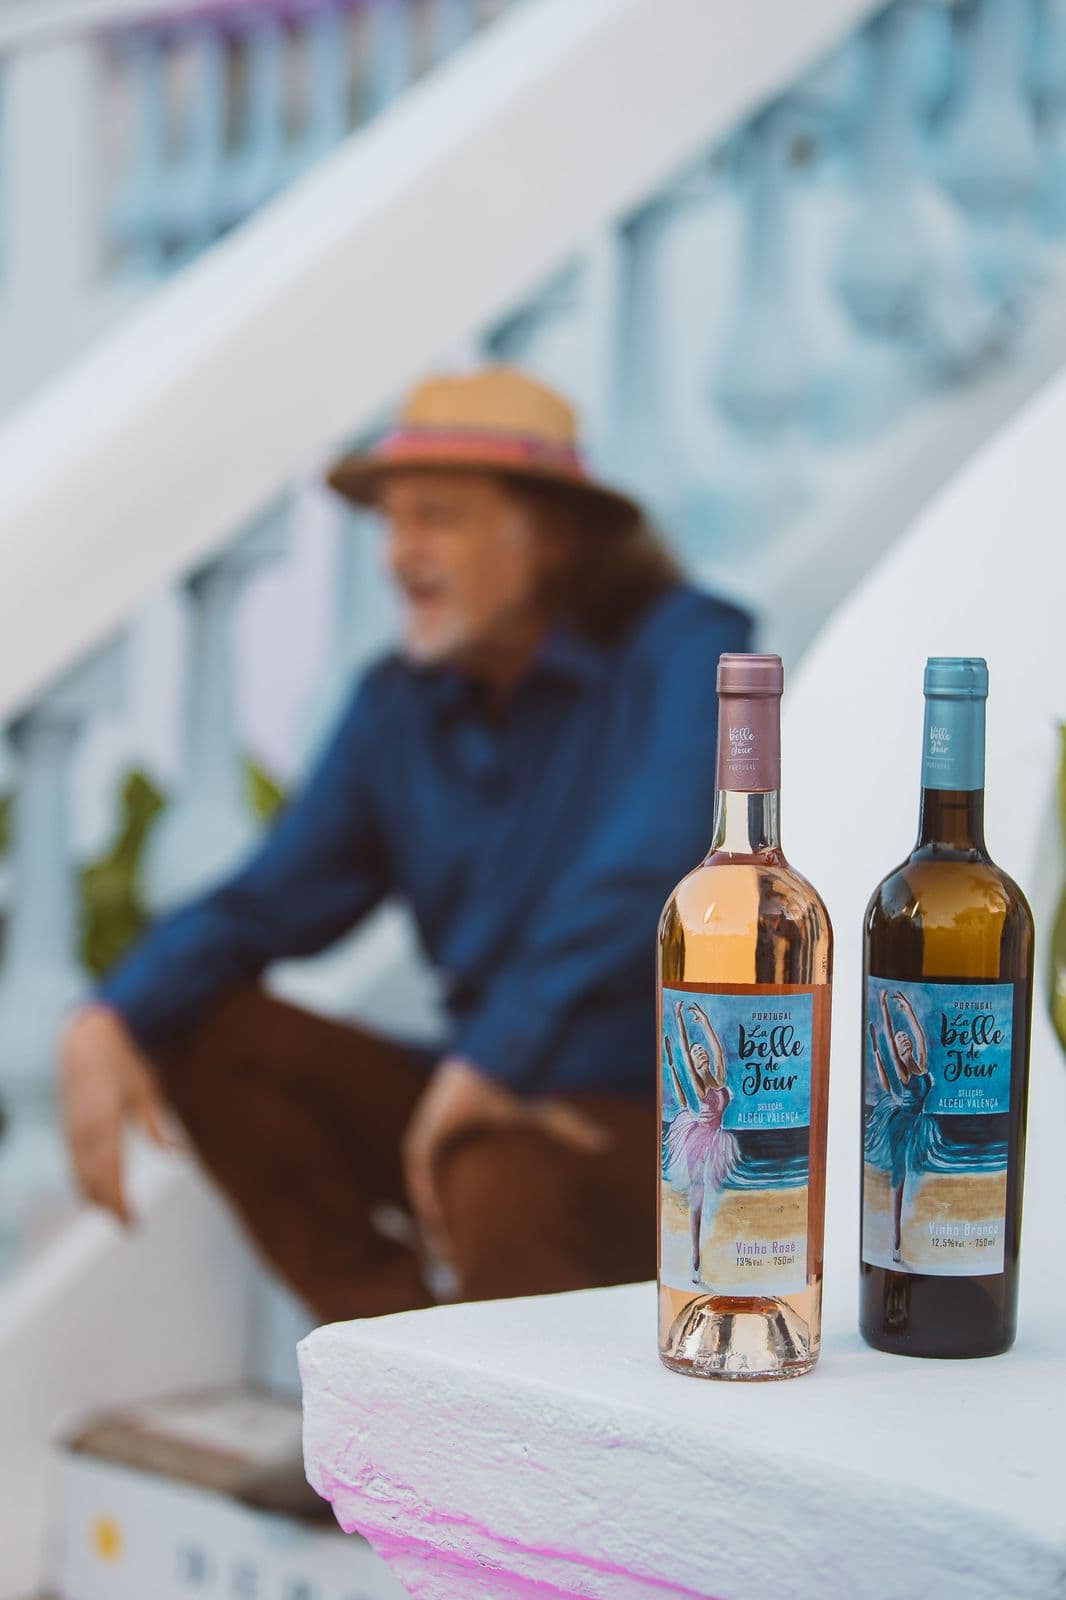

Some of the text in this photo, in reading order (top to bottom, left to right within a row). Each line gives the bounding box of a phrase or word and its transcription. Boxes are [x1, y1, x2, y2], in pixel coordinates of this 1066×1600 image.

[954, 1001, 993, 1010] PORTUGAL
[751, 1012, 793, 1021] PORTUGAL
[941, 1012, 1005, 1048] La belle
[738, 1023, 804, 1060] La belle
[944, 1044, 998, 1082] de Jour
[742, 1056, 798, 1096] de Jour
[938, 1098, 999, 1110] ALCEU VALENÇA
[737, 1111, 799, 1124] ALCEU VALENÇA
[929, 1222, 959, 1236] Vinho
[736, 1240, 796, 1255] Vinho Rosé
[975, 1237, 995, 1247] 750ml
[774, 1255, 795, 1266] 750ml
